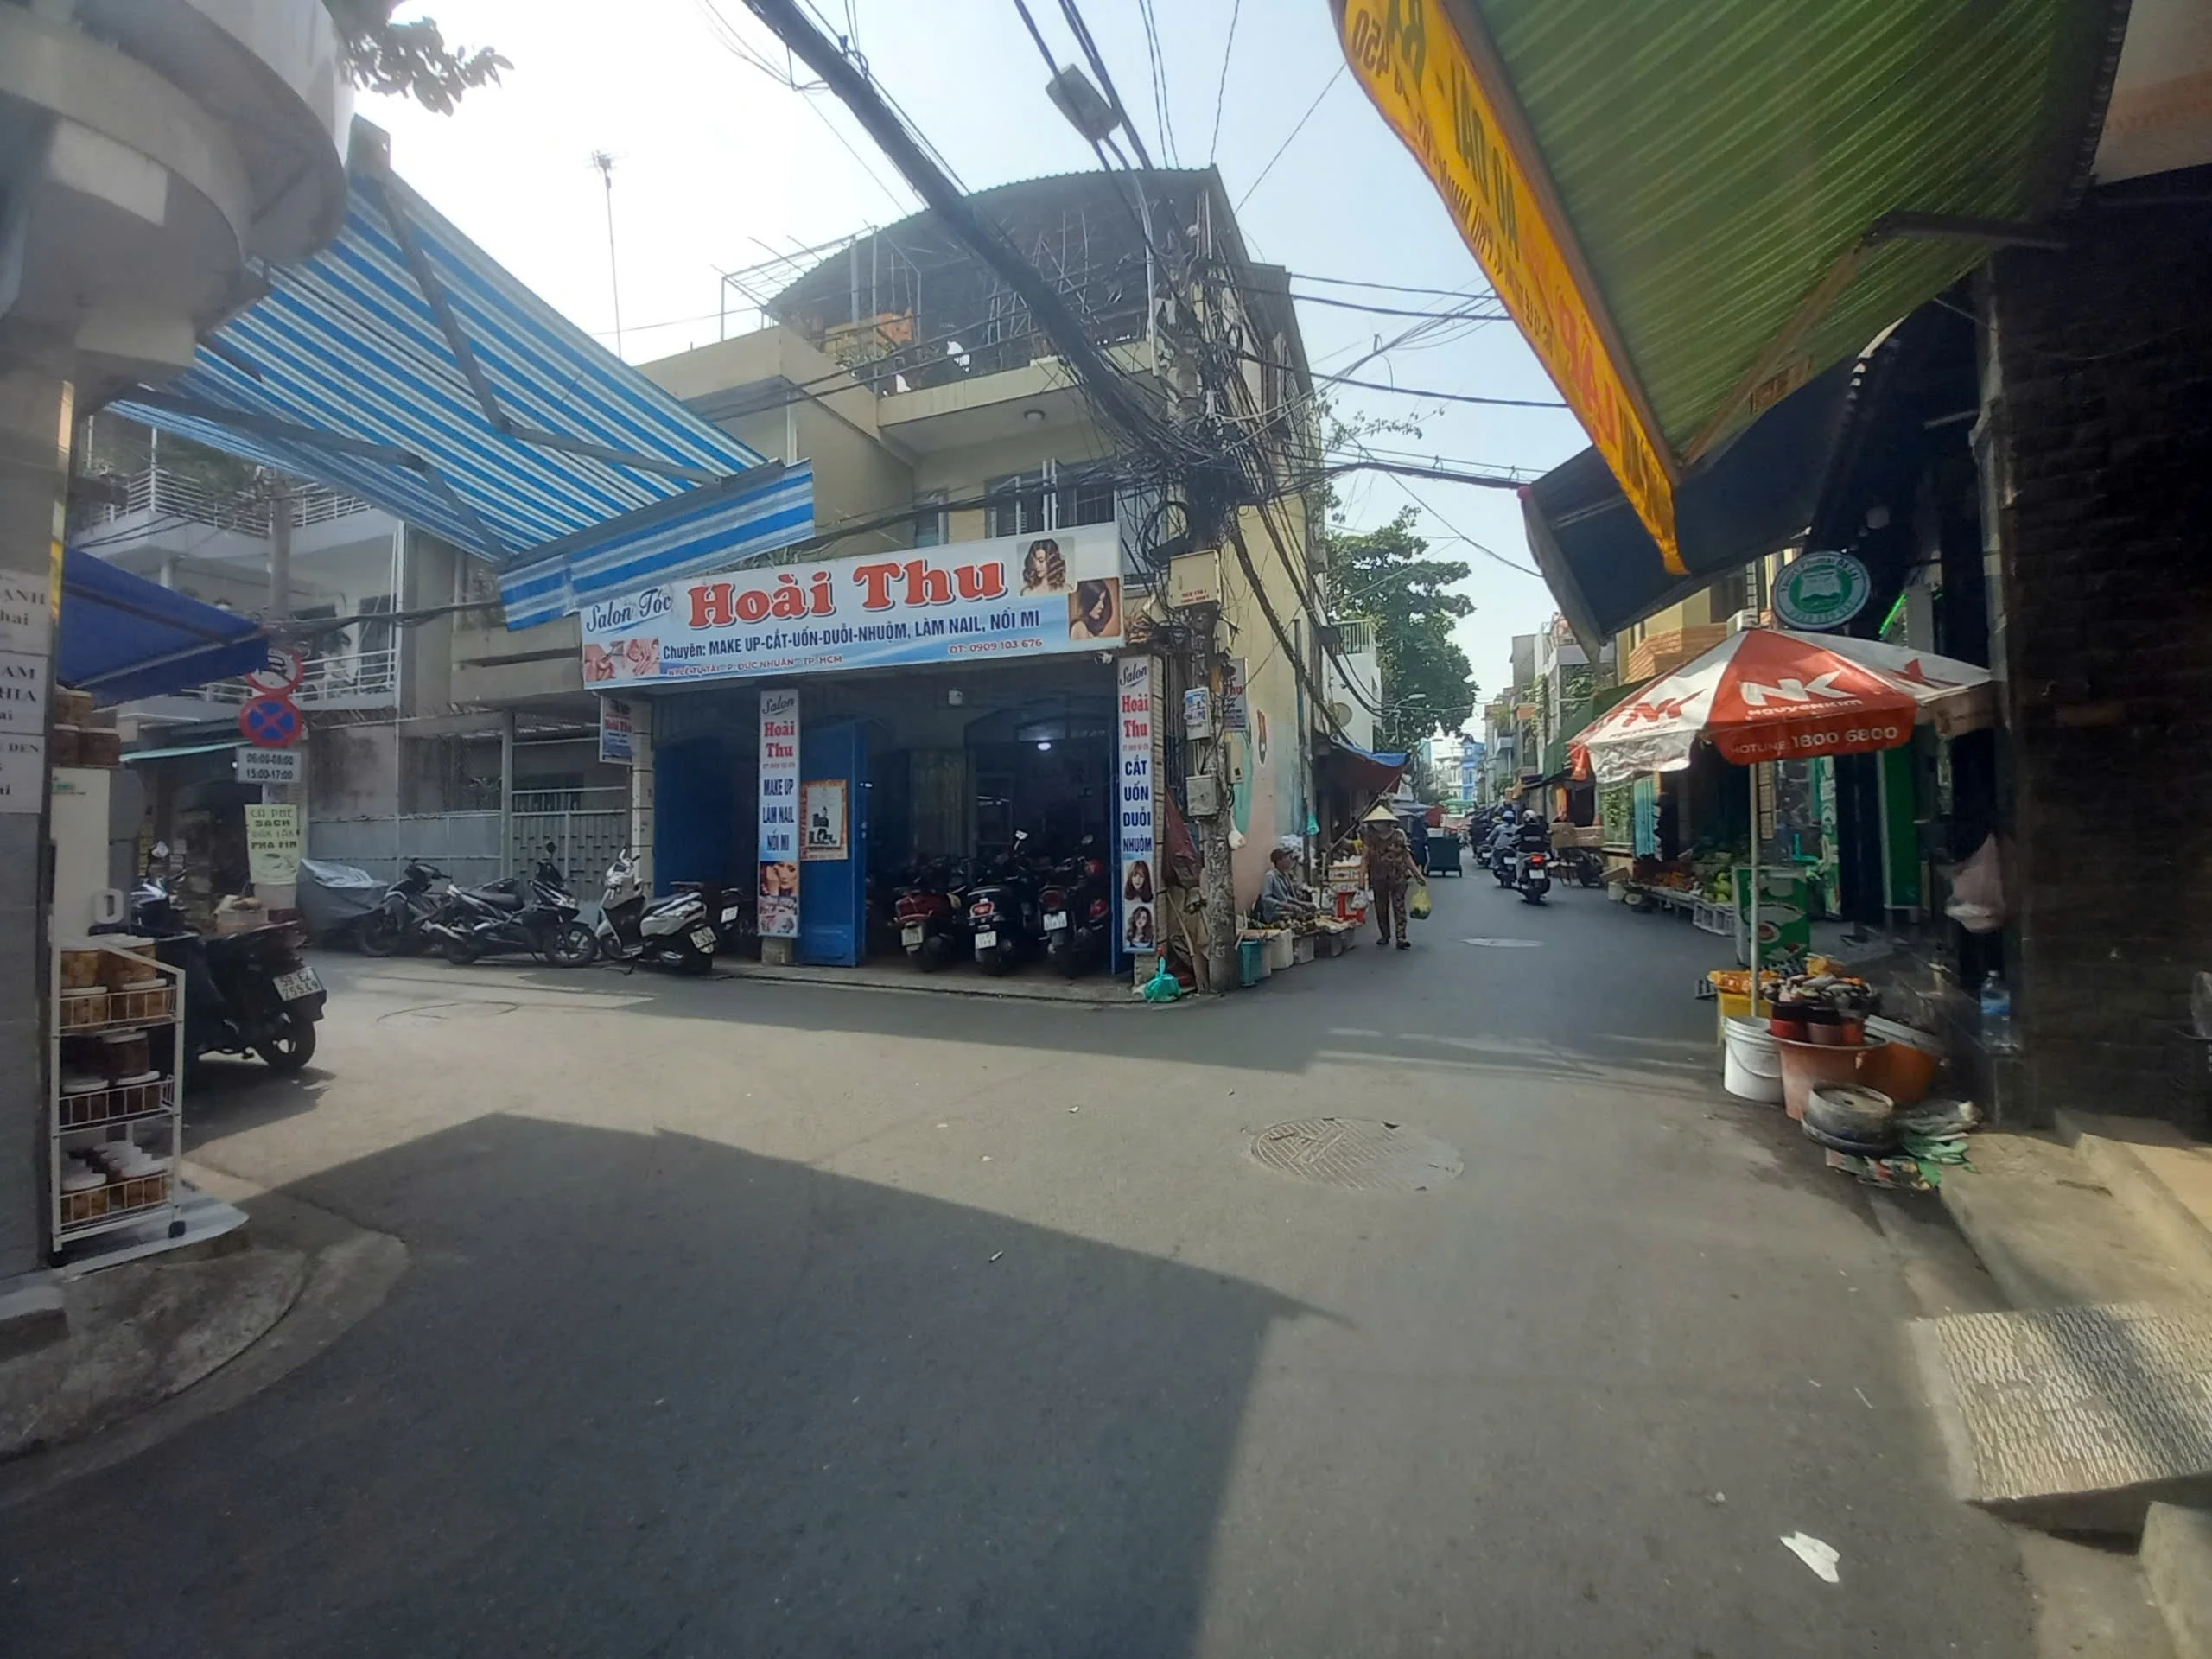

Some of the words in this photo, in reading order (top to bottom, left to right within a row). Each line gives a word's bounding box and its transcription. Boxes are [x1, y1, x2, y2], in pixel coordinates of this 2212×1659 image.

[688, 570, 836, 630] Hoài
[852, 559, 1007, 611] Thu
[586, 601, 632, 632] Salon
[639, 587, 671, 617] Tóc
[663, 643, 706, 661] Chuyên:
[709, 639, 741, 656] MAKE
[914, 617, 944, 638] LÀM
[950, 615, 986, 634] NAIL,
[1020, 610, 1040, 628] MI
[969, 641, 997, 652] 0909
[1000, 640, 1020, 650] 103
[1120, 663, 1147, 686] Salon
[1740, 670, 1859, 707] NK
[762, 695, 795, 715] Salon
[1122, 693, 1148, 714] Hoài
[764, 720, 795, 737] Hoài
[1123, 720, 1147, 738] Thu
[1791, 732, 1840, 748] 1800
[1844, 727, 1898, 743] 6800
[766, 743, 793, 758] Thu
[1125, 754, 1147, 776] CẮT
[764, 779, 783, 796] MAKE
[785, 778, 794, 796] UP
[1124, 781, 1149, 802] UỐN
[779, 806, 795, 823] NAIL
